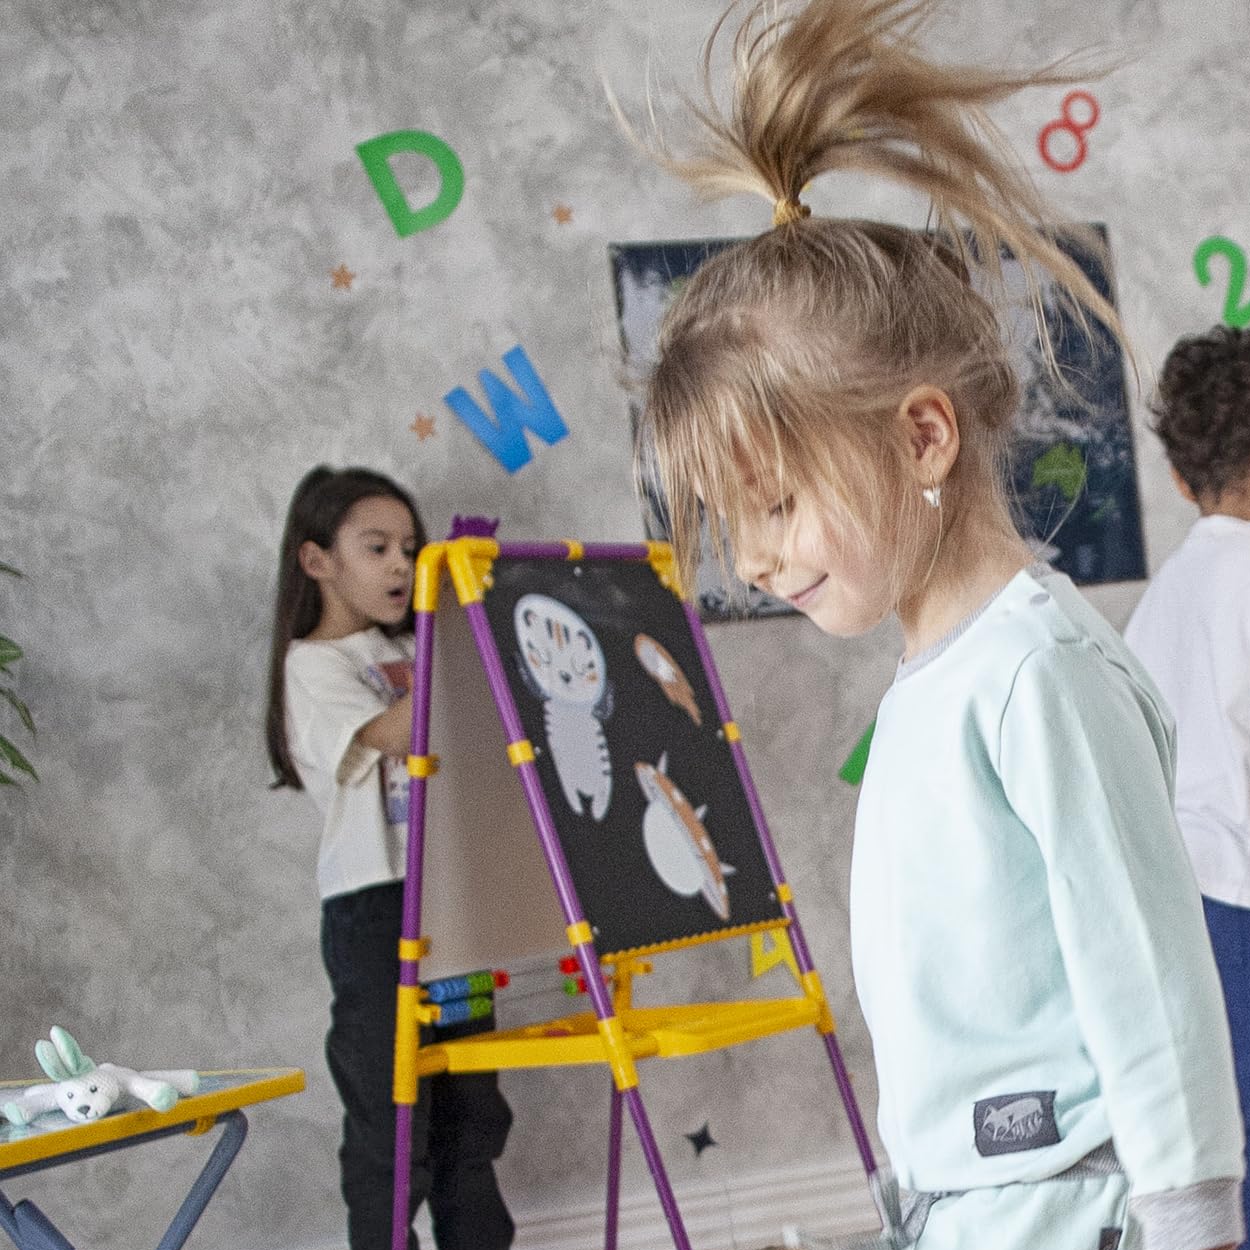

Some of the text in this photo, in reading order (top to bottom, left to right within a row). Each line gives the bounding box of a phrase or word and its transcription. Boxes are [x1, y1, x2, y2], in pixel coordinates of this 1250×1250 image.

[355, 129, 465, 239] D
[1038, 89, 1099, 173] 8
[442, 344, 570, 474] W
